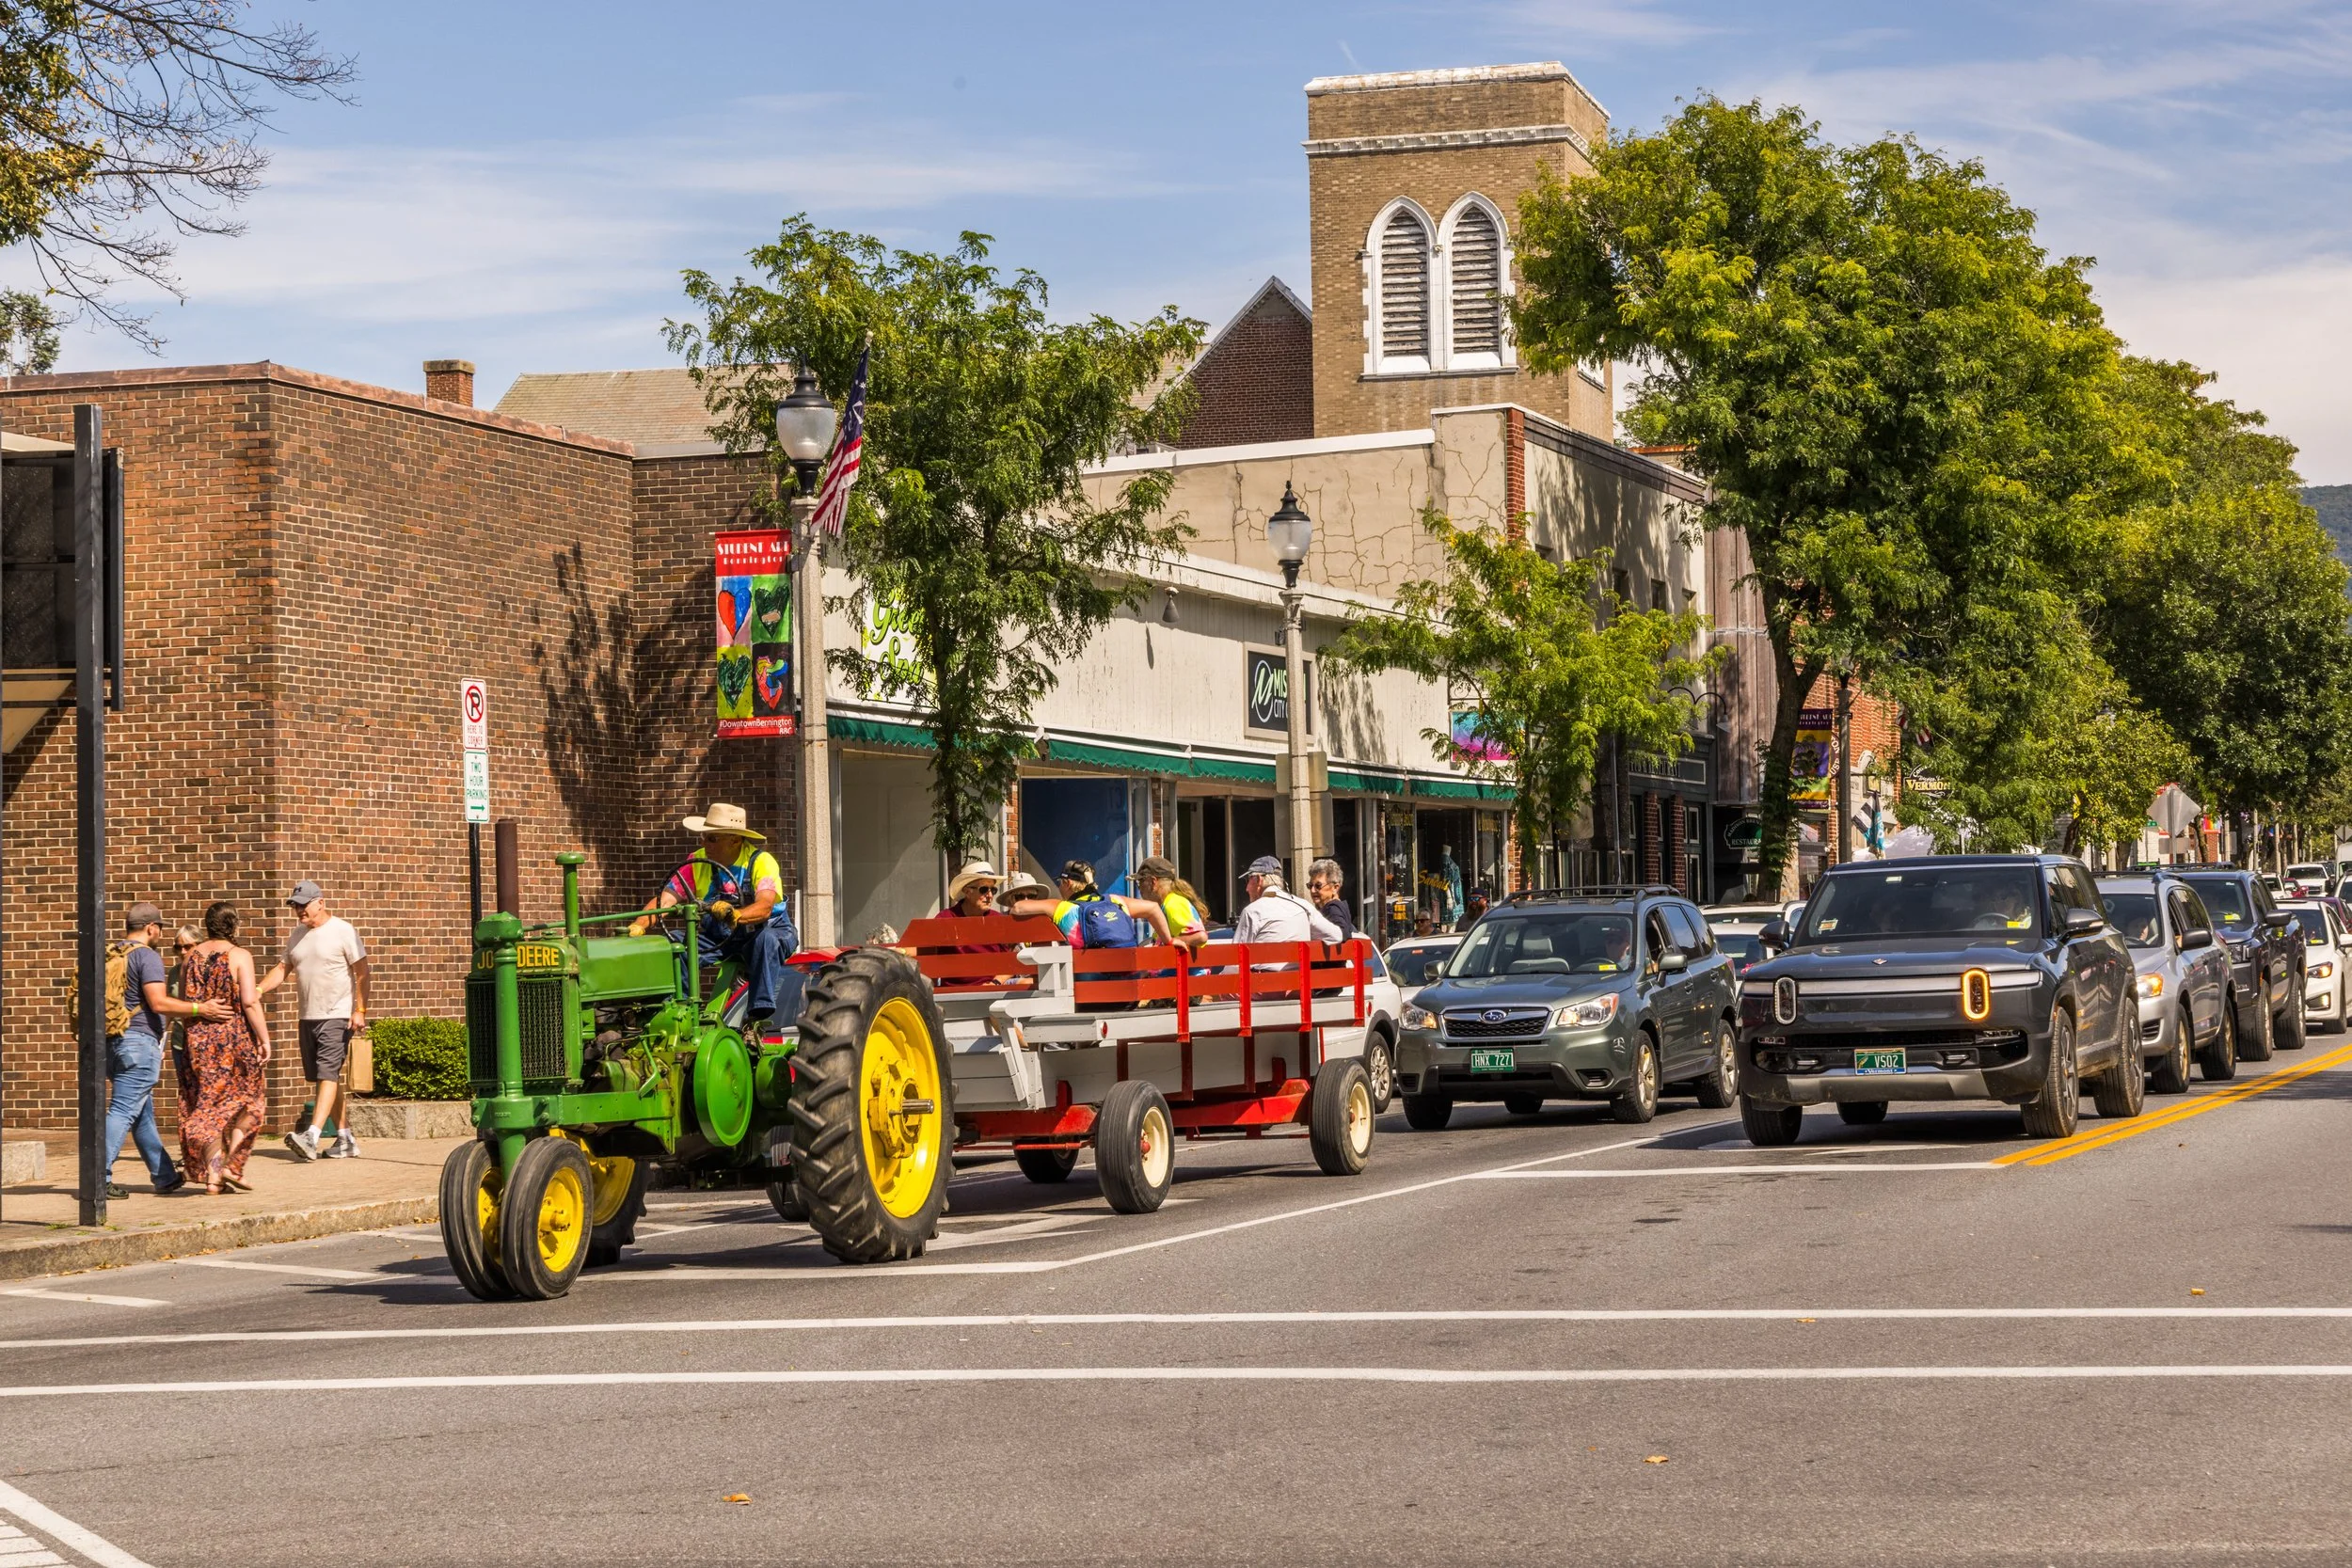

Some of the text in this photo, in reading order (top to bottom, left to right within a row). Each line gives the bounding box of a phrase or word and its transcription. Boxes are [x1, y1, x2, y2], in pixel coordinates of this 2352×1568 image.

[717, 541, 788, 555] STUDENT ART
[719, 718, 792, 728] #DowntownBennington
[470, 762, 482, 773] TWO
[469, 776, 484, 786] HOUR
[467, 789, 487, 800] PARKING
[517, 945, 559, 968] DEERE
[1475, 1055, 1509, 1067] HNX 727
